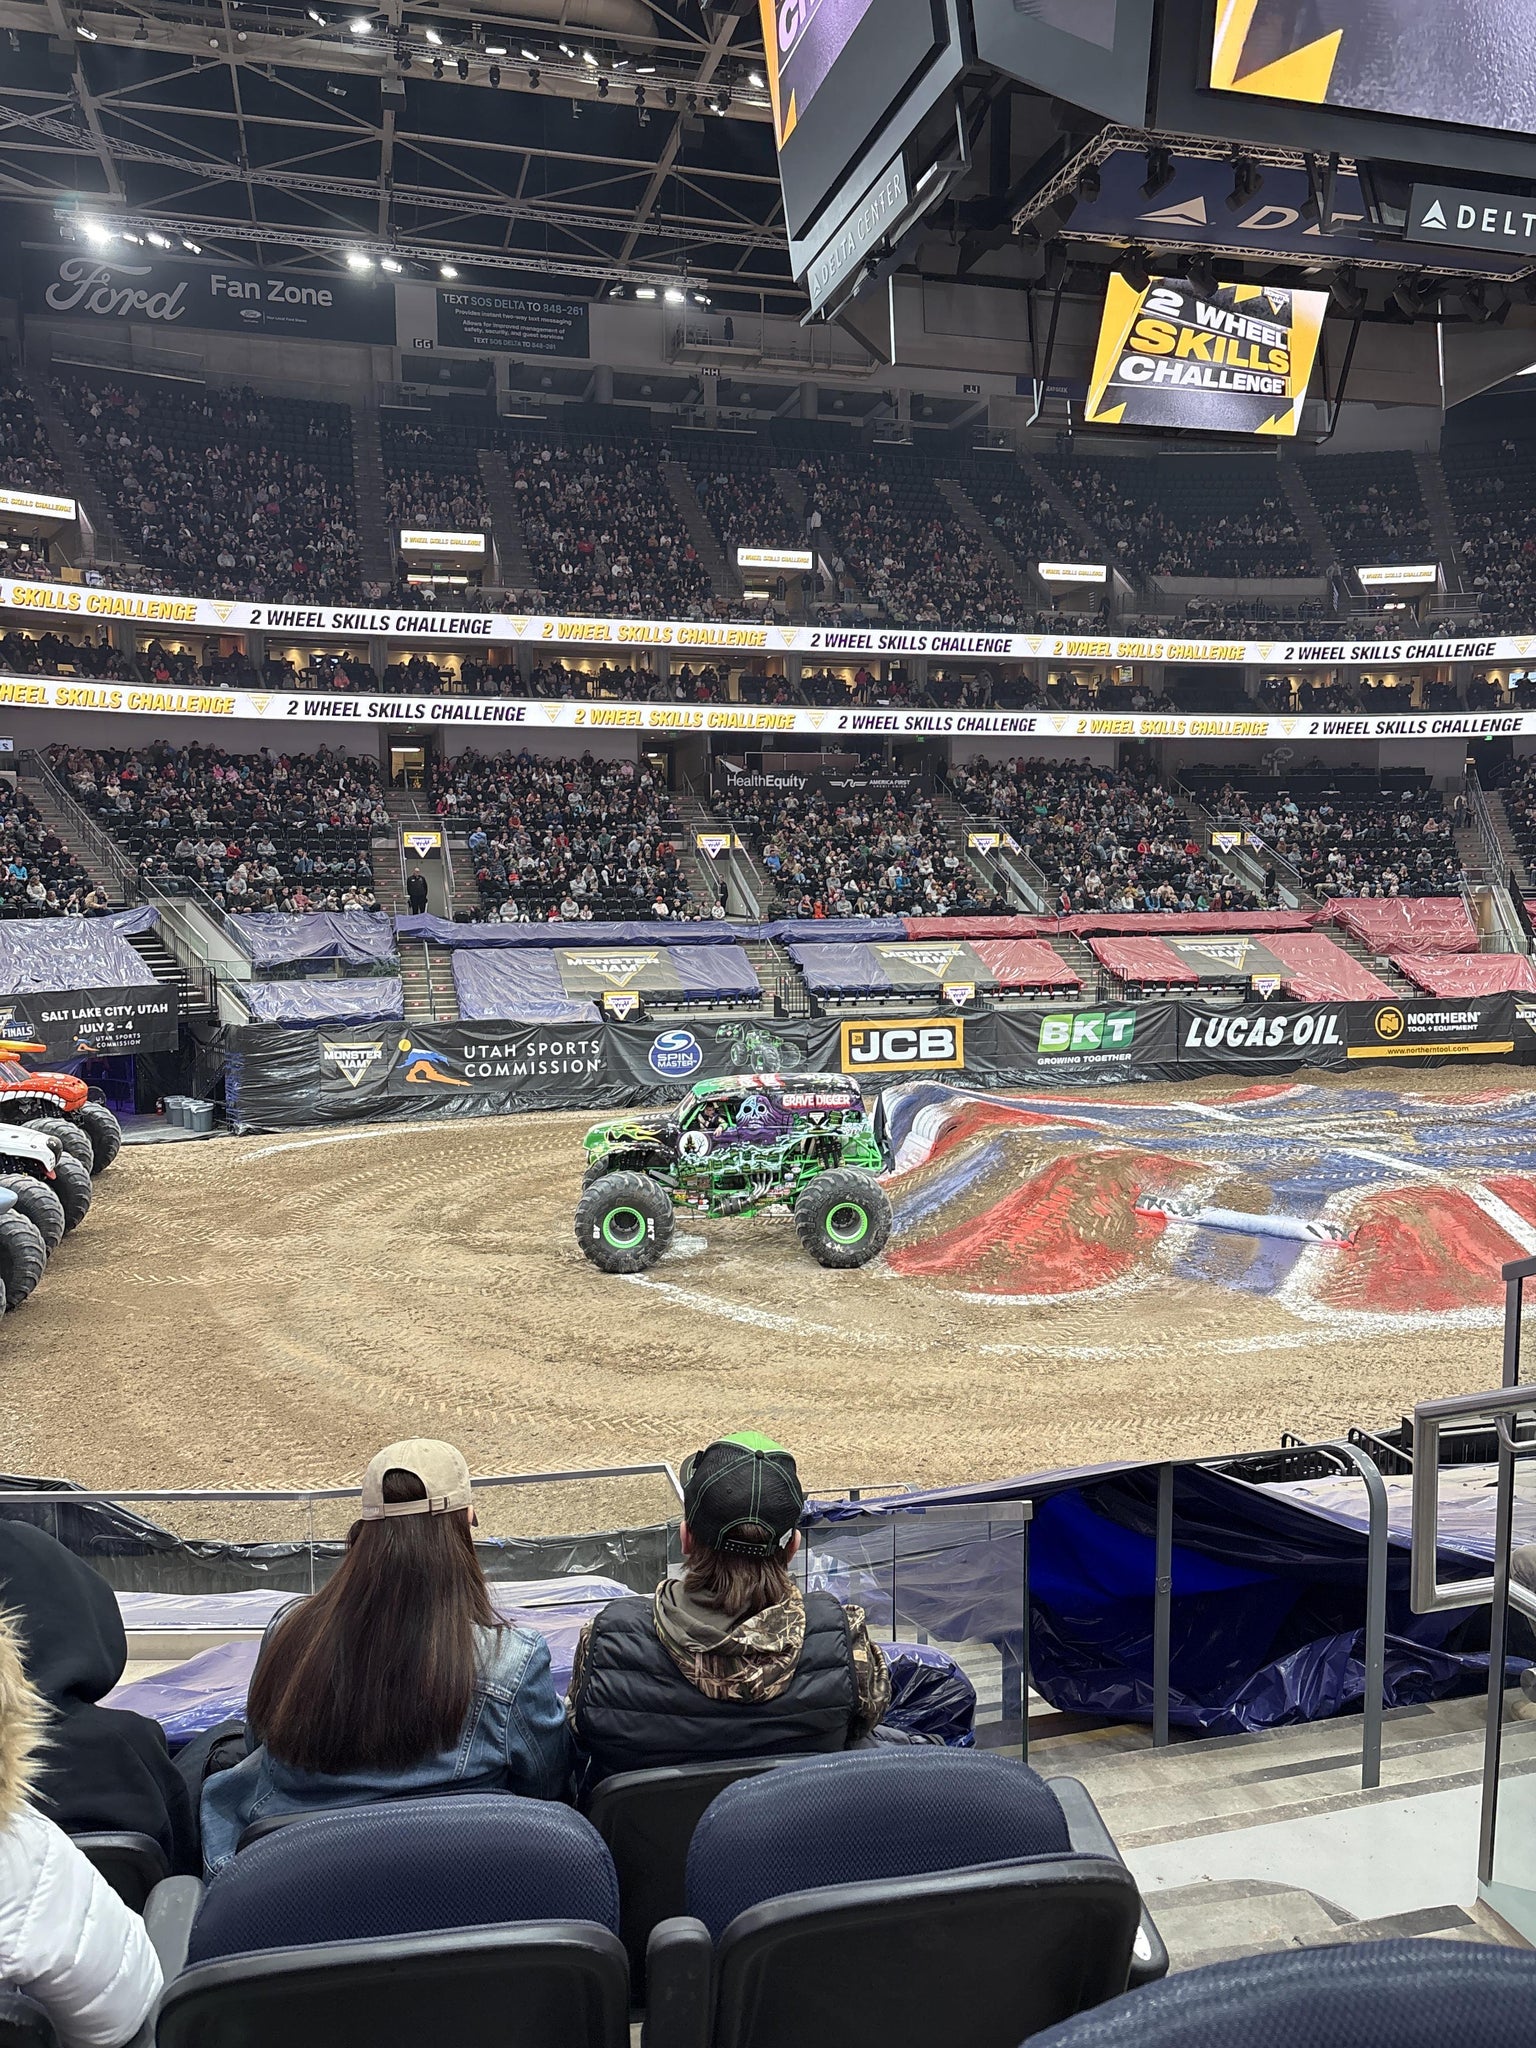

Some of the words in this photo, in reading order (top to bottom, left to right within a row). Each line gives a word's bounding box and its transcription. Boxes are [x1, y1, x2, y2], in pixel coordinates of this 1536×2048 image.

[822, 232, 856, 285] DELTA
[856, 174, 903, 240] CENTER
[45, 257, 189, 321] Ford
[211, 274, 261, 299] Fan
[267, 280, 333, 307] Zone
[443, 293, 469, 305] TEXT
[471, 297, 492, 308] SOS
[494, 299, 525, 310] DELTA
[527, 302, 540, 312] TO
[543, 303, 583, 316] 848-261
[455, 308, 480, 316] Provides
[502, 313, 527, 321] two-way
[541, 317, 572, 326] messaging
[1145, 288, 1184, 317] 2
[1195, 300, 1288, 351] WHEEL
[462, 319, 482, 327] Allows
[521, 325, 557, 334] management
[415, 339, 431, 349] GG
[1129, 318, 1290, 375] SKILLS
[703, 368, 719, 376] HH
[1118, 355, 1284, 394] CHALLENGE
[12, 586, 81, 610] SKILLS
[86, 594, 198, 621] CHALLENGE
[250, 609, 262, 625] 2
[267, 610, 326, 628] WHEEL
[331, 613, 391, 631] SKILLS
[395, 616, 493, 635] CHALLENGE
[542, 622, 553, 638] 2
[557, 624, 611, 641] WHEEL
[617, 626, 672, 643] SKILLS
[676, 627, 767, 646] CHALLENGE
[810, 633, 821, 647] 2
[825, 634, 873, 649] WHEEL
[878, 635, 927, 651] SKILLS
[931, 637, 1012, 653] CHALLENGE
[1053, 641, 1063, 655] 2
[1066, 641, 1112, 657] WHEEL
[1116, 643, 1163, 658] SKILLS
[1166, 644, 1245, 660] CHALLENGE
[1284, 647, 1294, 660] 2
[1298, 646, 1346, 660] WHEEL
[1350, 645, 1401, 660] SKILLS
[1405, 642, 1496, 659] CHALLENGE
[0, 683, 48, 704] HEEL
[55, 687, 122, 709] SKILLS
[127, 692, 236, 714] CHALLENGE
[287, 700, 298, 715] 2
[304, 700, 362, 717] WHEEL
[367, 702, 425, 719] SKILLS
[430, 704, 526, 721] CHALLENGE
[574, 708, 585, 724] 2
[590, 709, 643, 726] WHEEL
[649, 710, 702, 727] SKILLS
[707, 712, 796, 729] CHALLENGE
[838, 716, 848, 729] 2
[852, 716, 900, 730] WHEEL
[904, 716, 953, 731] SKILLS
[957, 718, 1037, 732] CHALLENGE
[1076, 719, 1086, 733] 2
[1090, 720, 1135, 734] WHEEL
[1139, 721, 1186, 736] SKILLS
[1189, 721, 1268, 736] CHALLENGE
[1309, 722, 1319, 735] 2
[1323, 722, 1371, 735] WHEEL
[1375, 720, 1427, 735] SKILLS
[1431, 718, 1523, 734] CHALLENGE
[727, 774, 806, 790] HealthEquity
[880, 949, 966, 958] MONSTER
[1176, 943, 1256, 952] MONSTER
[1205, 949, 1242, 958] JAM
[567, 958, 660, 966] MONSTER
[595, 964, 638, 973] JAM
[910, 956, 948, 964] JAM
[41, 1010, 69, 1022] SALT
[72, 1007, 101, 1019] LAKE
[105, 1005, 135, 1018] CITY,
[138, 1003, 168, 1014] UTAH
[1407, 1012, 1479, 1025] NORTHERN
[2, 1025, 33, 1038] FINALS
[79, 1022, 105, 1034] JULY
[107, 1022, 115, 1032] 2
[125, 1021, 133, 1030] 4
[1041, 1017, 1134, 1045] BKT
[1185, 1015, 1289, 1048] LUCAS
[1433, 1024, 1478, 1032] EQUIPMENT
[95, 1034, 113, 1042] UTAH
[96, 1039, 141, 1048] COMMISSION
[851, 1028, 954, 1062] JCB
[324, 1050, 382, 1060] MONSTER
[464, 1044, 516, 1059] UTAH
[526, 1040, 600, 1057] SPORTS
[657, 1052, 694, 1061] SPIN
[1386, 1045, 1469, 1054] www.northerntool.com
[338, 1060, 369, 1069] JAM
[658, 1060, 694, 1068] MASTER
[1037, 1056, 1081, 1065] GROWING
[1083, 1053, 1132, 1063] TOGETHER
[464, 1058, 601, 1078] COMMISSION
[782, 1094, 815, 1107] GRAVE
[816, 1094, 851, 1107] DIGGER
